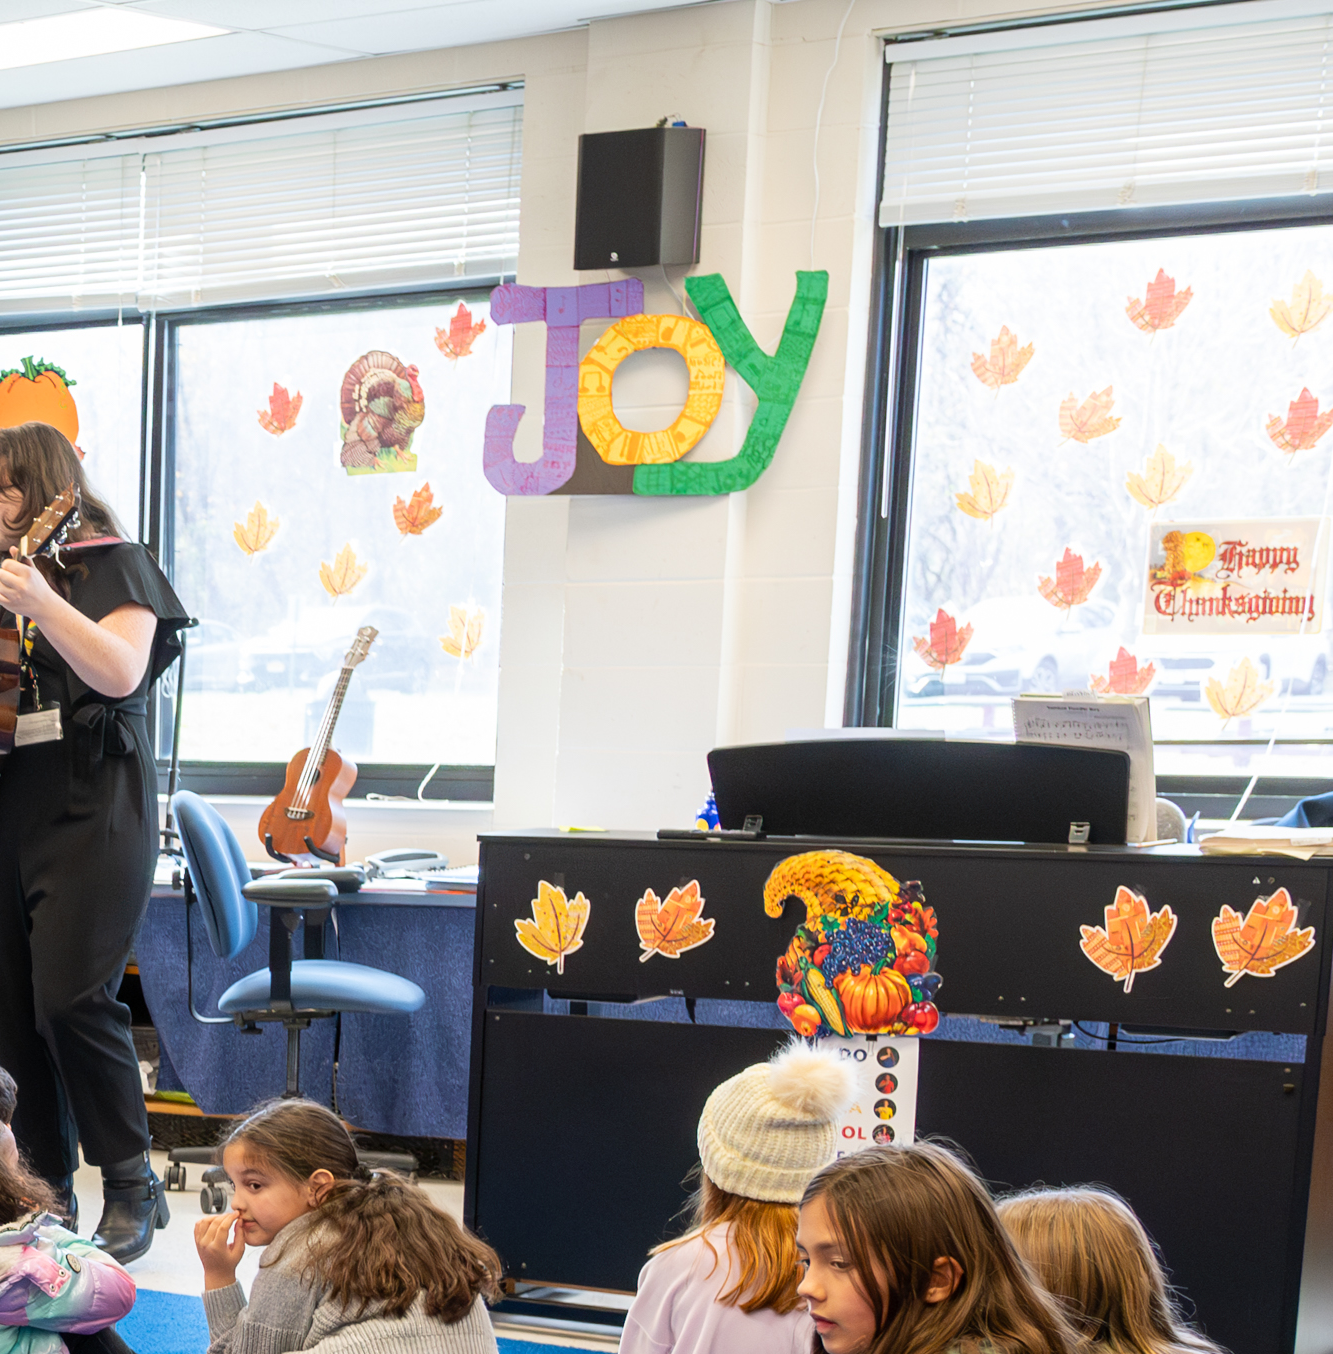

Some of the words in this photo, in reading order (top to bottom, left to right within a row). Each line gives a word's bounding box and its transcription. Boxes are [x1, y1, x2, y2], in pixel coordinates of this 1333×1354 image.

[1216, 539, 1300, 579] Happy
[1150, 579, 1315, 623] Thanksgiving
[842, 1125, 867, 1140] OL
